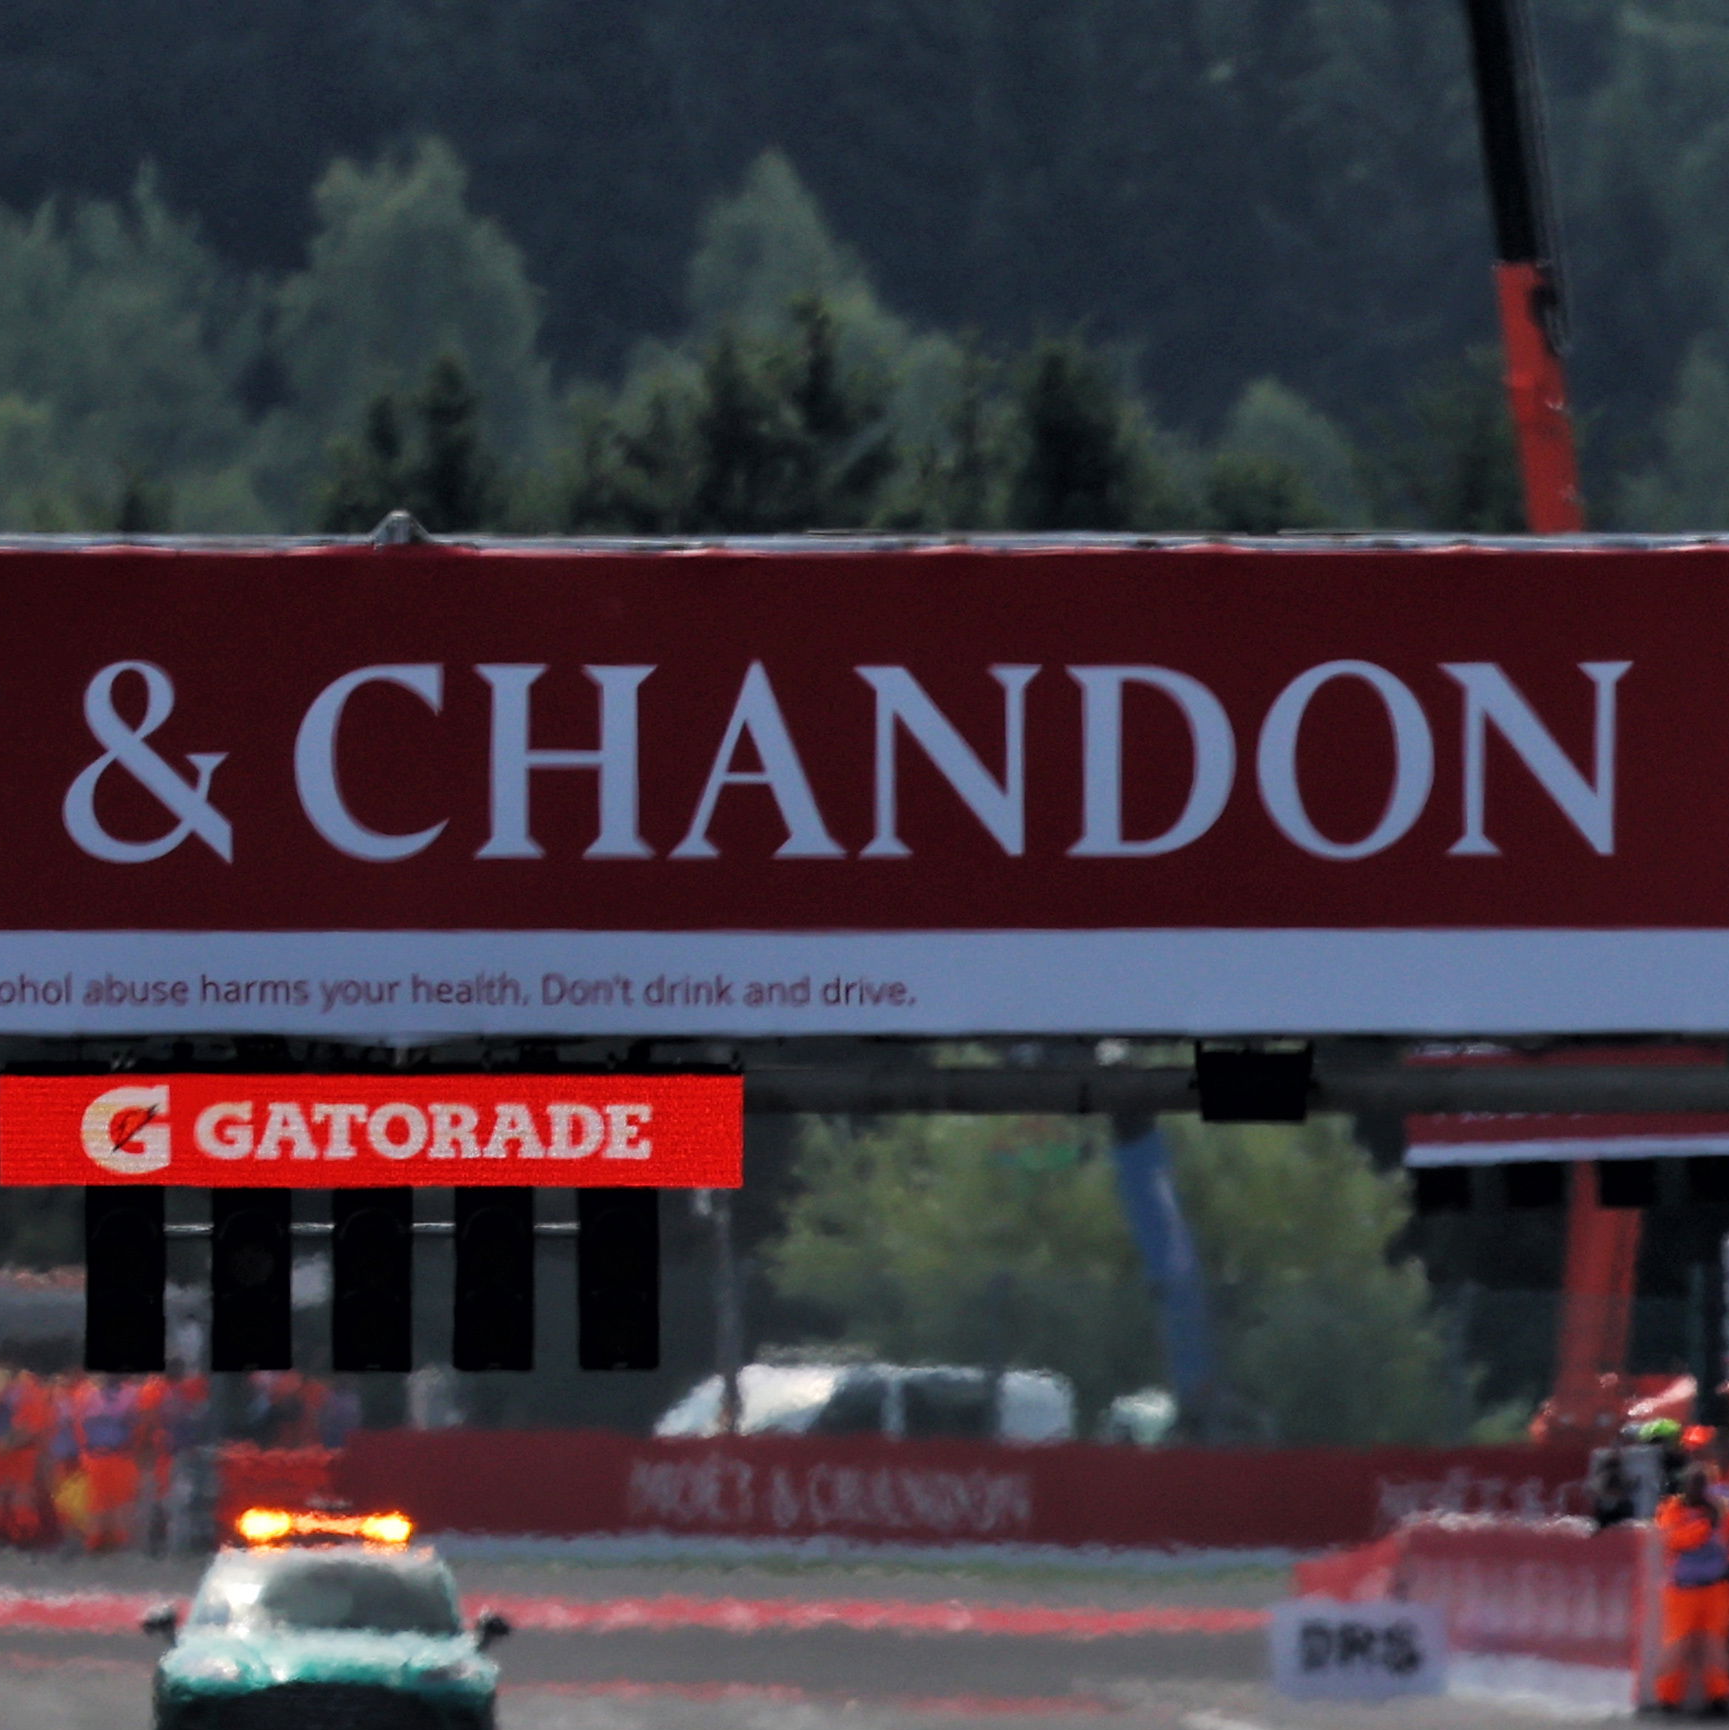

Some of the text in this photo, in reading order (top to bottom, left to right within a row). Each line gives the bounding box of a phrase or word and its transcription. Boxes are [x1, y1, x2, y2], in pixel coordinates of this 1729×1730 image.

[62, 658, 234, 865] &
[293, 657, 1635, 863] CHANDON
[81, 972, 189, 1006] abuse
[200, 973, 308, 1006] harms
[318, 977, 402, 1015] your
[541, 972, 634, 1008] Don't
[643, 973, 733, 1008] drink
[742, 973, 812, 1008] and
[193, 1102, 653, 1161] GATORADE
[1299, 1617, 1424, 1679] DRS
